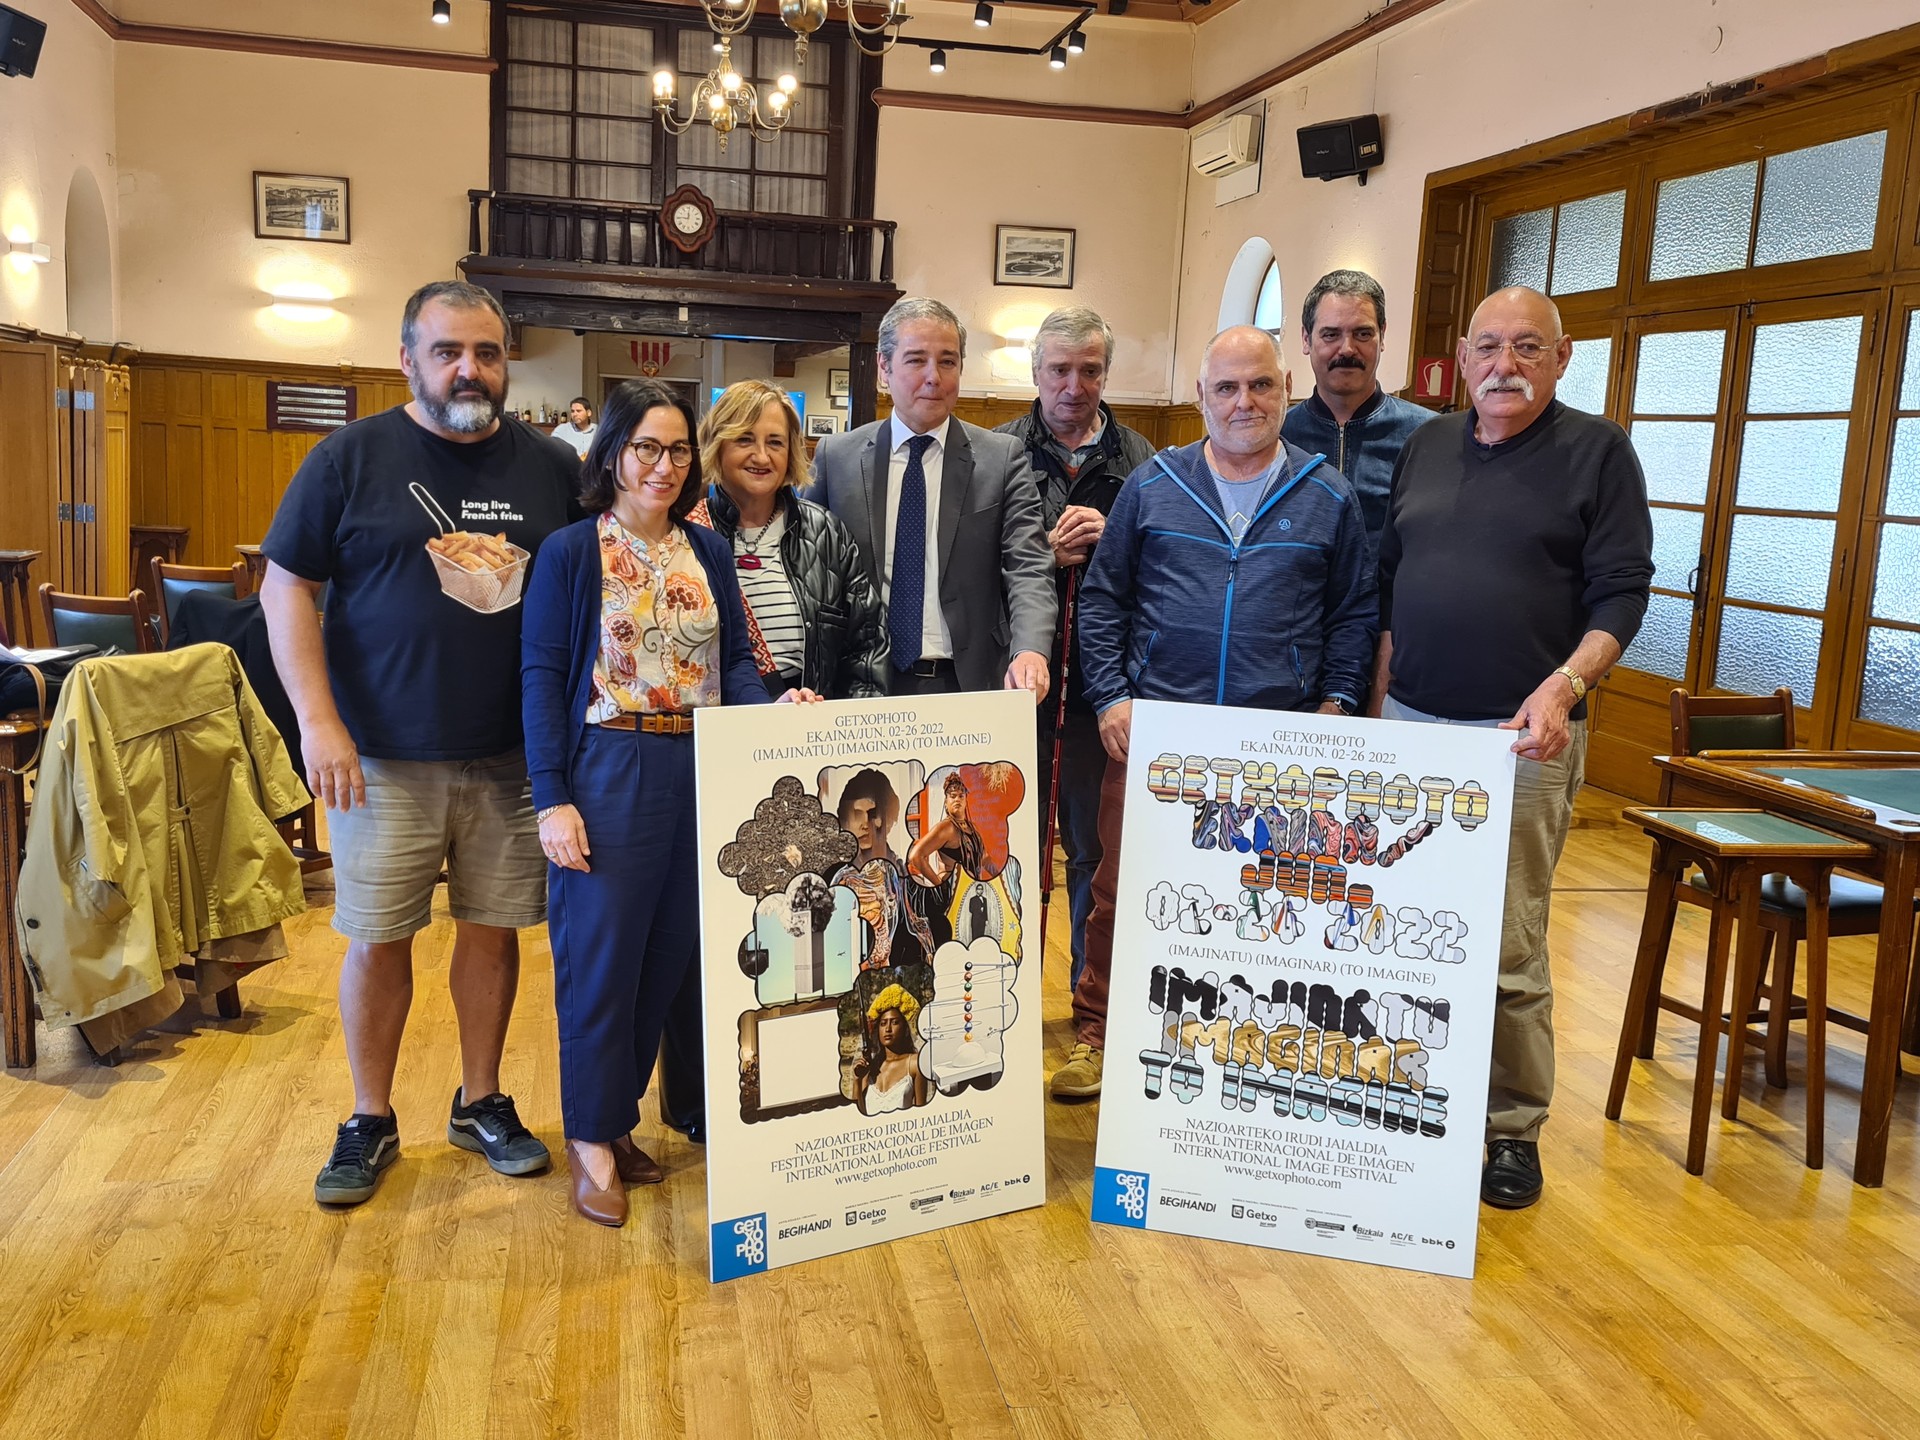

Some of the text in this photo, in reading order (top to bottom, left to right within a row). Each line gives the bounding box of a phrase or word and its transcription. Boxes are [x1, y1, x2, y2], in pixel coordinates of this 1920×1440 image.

[461, 499, 510, 511] Long live
[461, 510, 524, 521] French fries
[835, 711, 916, 727] GETXOPHOTO
[806, 722, 944, 743] EKAINA/JUN. 02-26 2022
[1272, 730, 1366, 748] GETXOPHOTO
[753, 732, 992, 762] (IMAJINATU) (IMAGINAR) (TO IMAGINE)
[1240, 740, 1397, 764] EKAINA/JUN. 02-26 2022
[1147, 752, 1490, 832] GETXOPHOTO
[1146, 880, 1468, 964] 02-26 2022
[1168, 944, 1436, 986] (IMAJINATU) (IMAGINAR) (TO IMAGINE)
[1148, 965, 1451, 1050] IMAJINATU
[1160, 1010, 1429, 1091] IMAGINAR
[1139, 1049, 1449, 1139] TO IMAGINE
[795, 1108, 972, 1154] NAZIOARTEKO IRUDI JAIALDIA
[1186, 1118, 1388, 1156] NAZIOARTEKO IRUDI JAIALDIA
[771, 1116, 994, 1173] FESTIVAL INTERNACIONAL DE IMAGEN
[1159, 1127, 1415, 1173] FESTIVAL INTERNACIONAL DE IMAGEN
[786, 1132, 982, 1184] INTERNATIONAL IMAGE FESTIVAL
[1173, 1143, 1398, 1184] INTERNATIONAL IMAGE FESTIVAL
[835, 1156, 938, 1186] www.getxophoto.com
[1004, 1178, 1022, 1186] bbk
[1224, 1164, 1342, 1190] www.getxophoto.com
[954, 1188, 976, 1199] Bizkaia
[980, 1182, 998, 1192] AC/E
[858, 1208, 886, 1220] Getxo
[1160, 1196, 1216, 1212] BEGIHANDI
[1246, 1208, 1278, 1222] Getxo
[778, 1218, 832, 1240] BEGIHANDI
[1356, 1226, 1384, 1238] Bizkaia
[1390, 1232, 1414, 1242] AC/E
[1422, 1238, 1444, 1246] bbk
